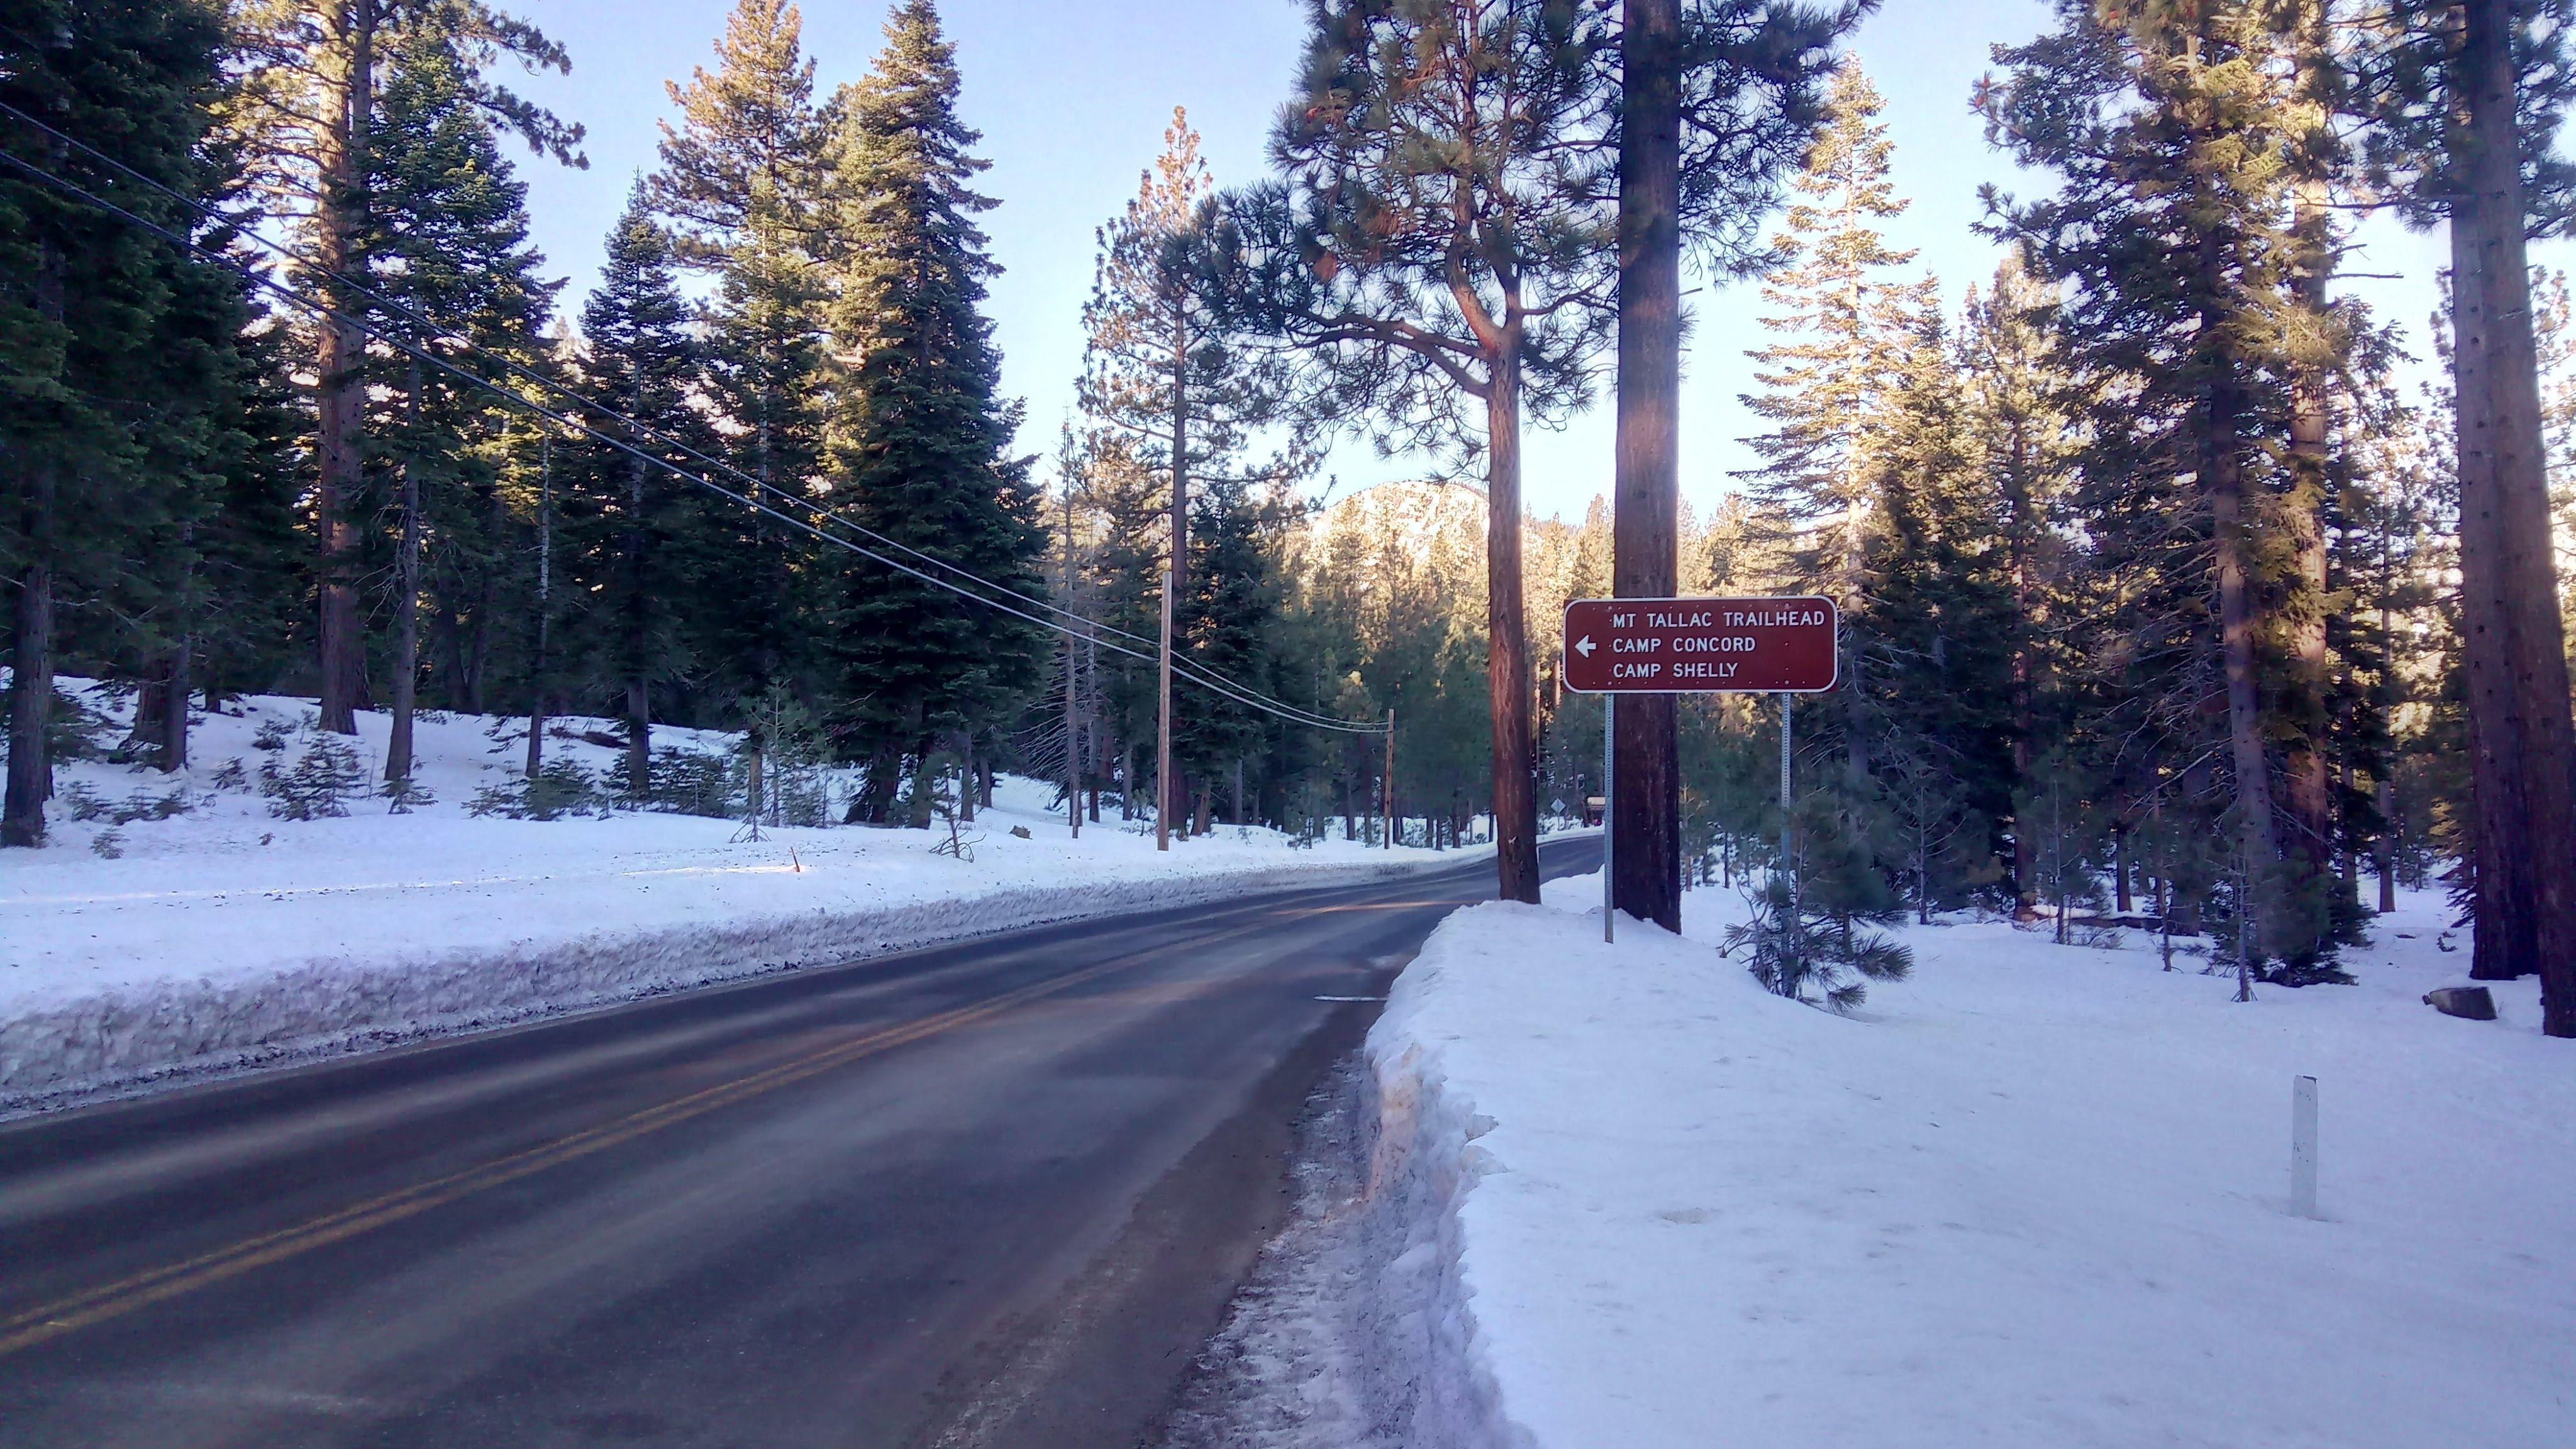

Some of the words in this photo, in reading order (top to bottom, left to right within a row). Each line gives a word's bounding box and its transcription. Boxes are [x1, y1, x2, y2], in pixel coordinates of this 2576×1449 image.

[1613, 613, 1636, 628] MT
[1646, 612, 1713, 628] TALLAC
[1723, 611, 1824, 627] TRAILHEAD
[1613, 638, 1662, 653] CAMP
[1673, 637, 1756, 652] CONCORD
[1613, 663, 1662, 678] CAMP
[1673, 662, 1738, 678] SHELLY
